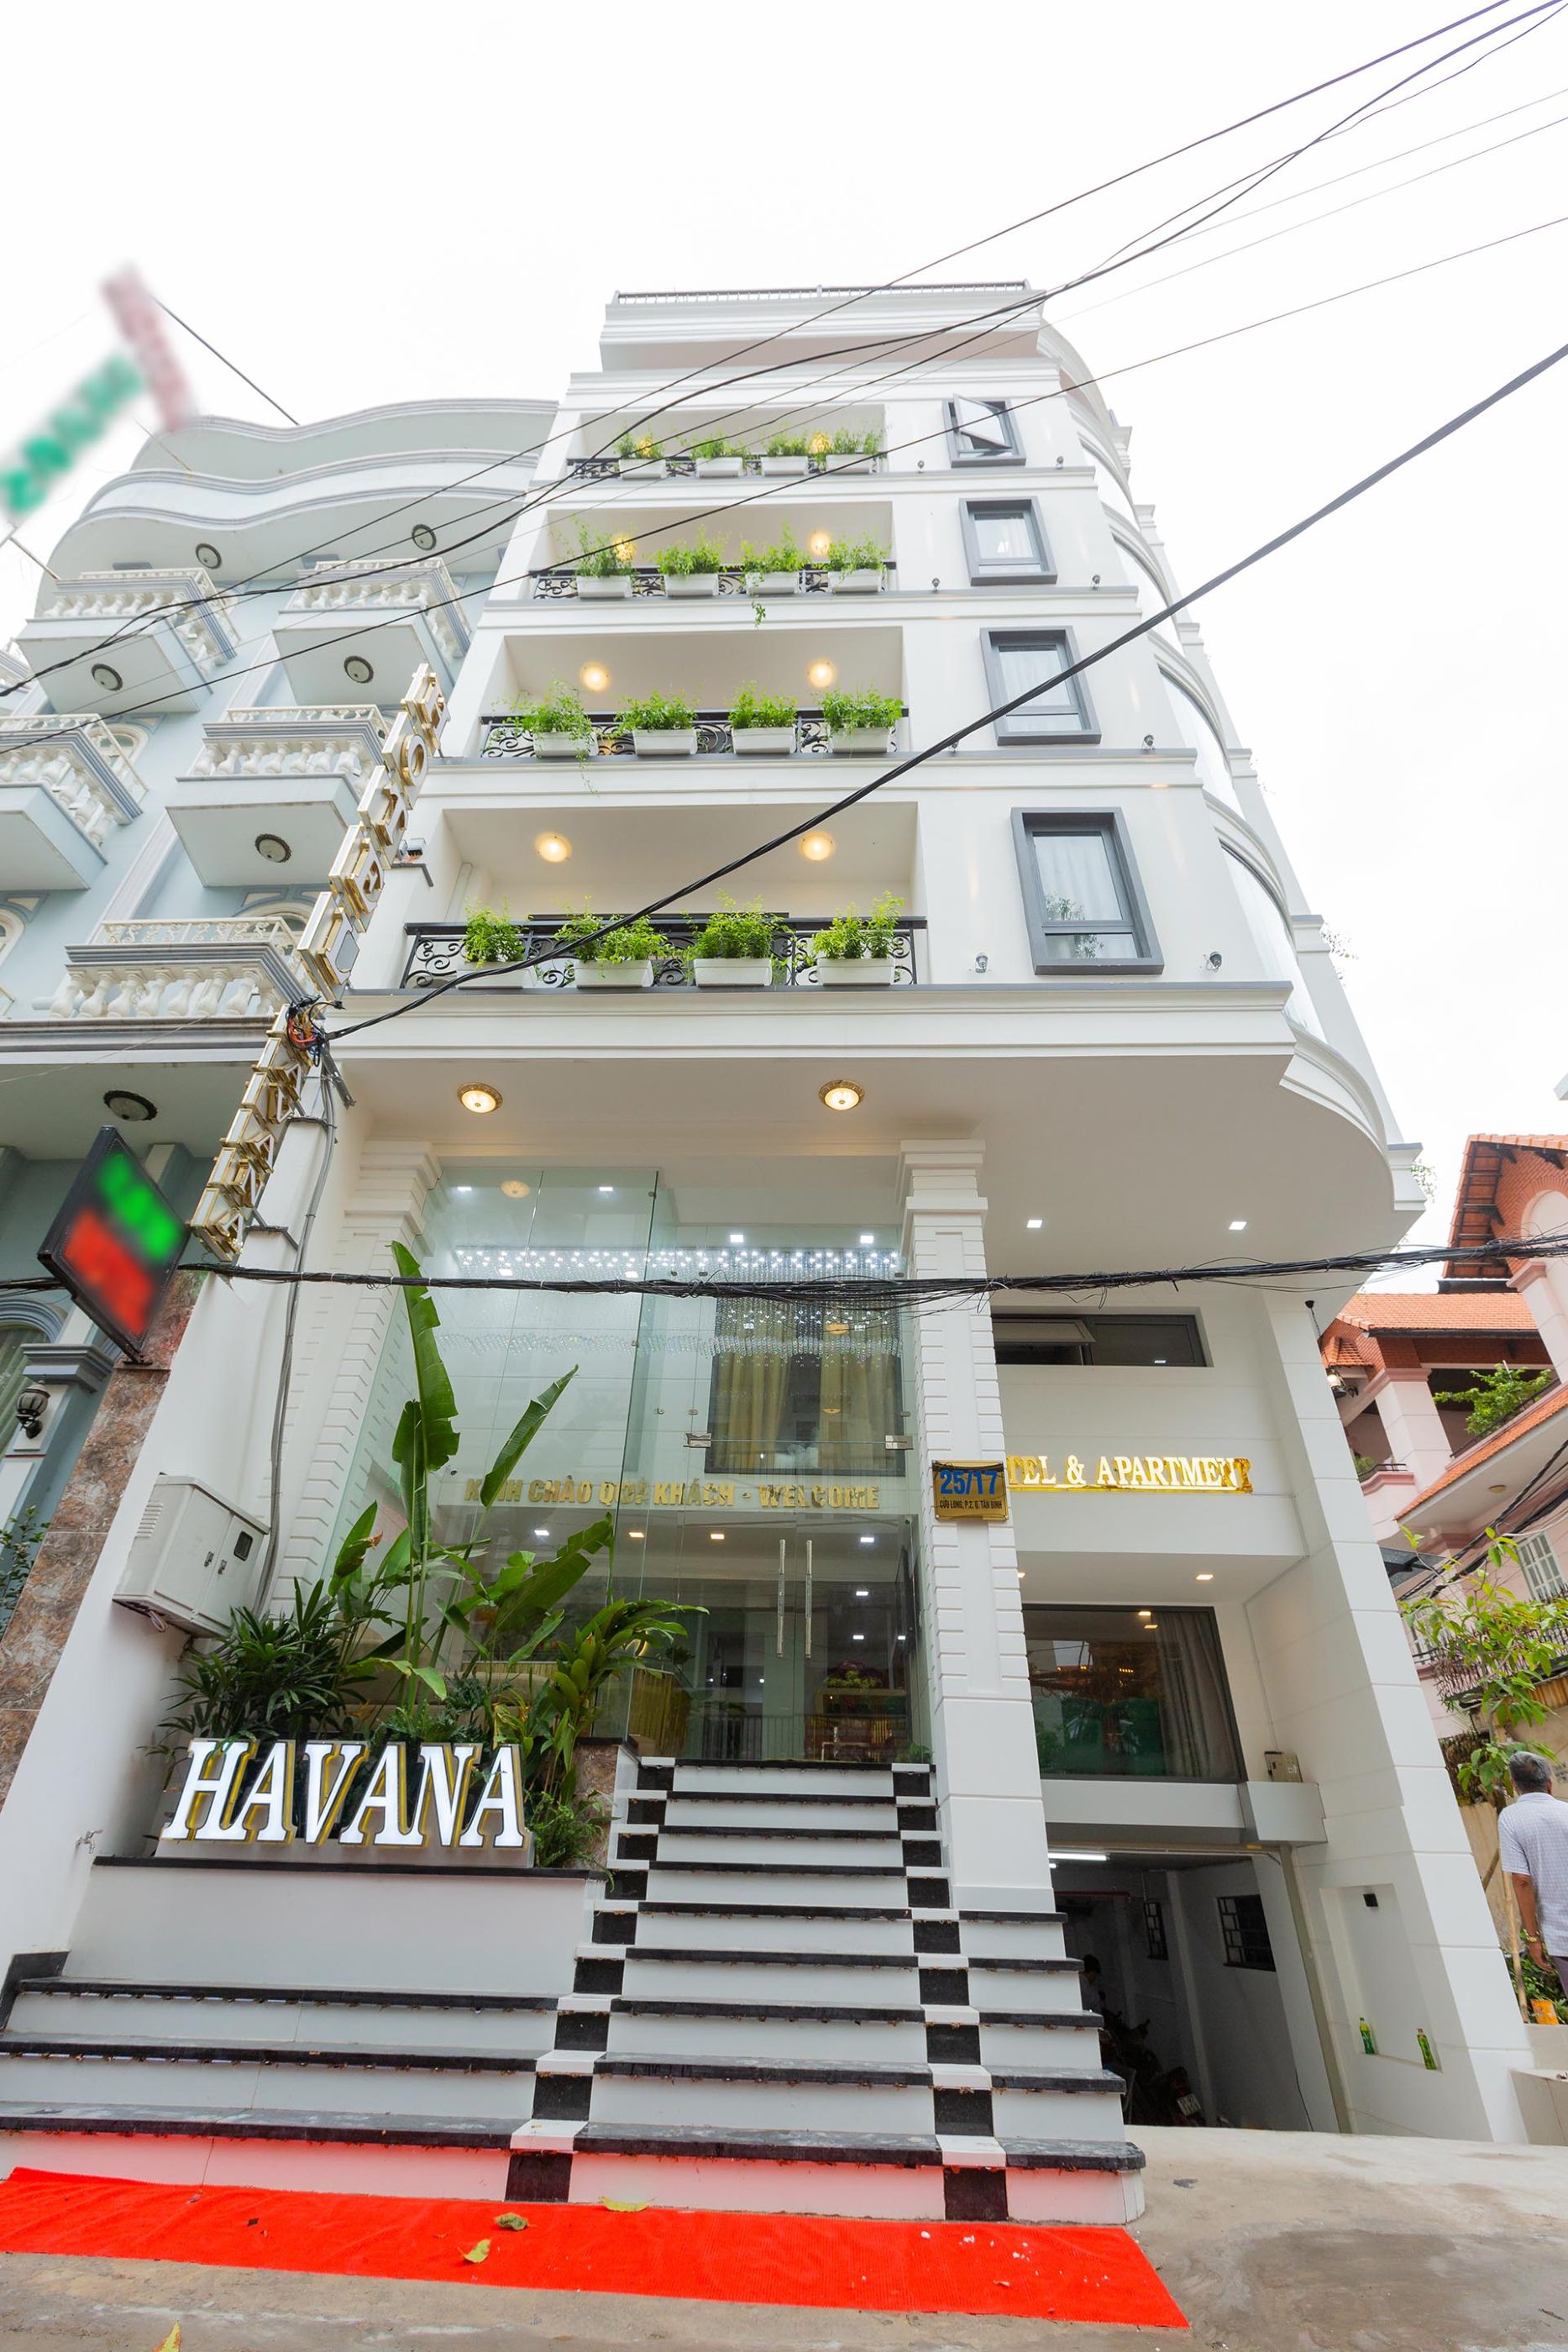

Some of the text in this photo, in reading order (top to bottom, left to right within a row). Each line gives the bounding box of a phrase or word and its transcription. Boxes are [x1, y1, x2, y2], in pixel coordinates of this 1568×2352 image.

[940, 1468, 998, 1495] 25/17
[1067, 1454, 1087, 1486] &
[758, 1484, 880, 1509] WELCOME
[160, 1739, 526, 1849] HAVANA
